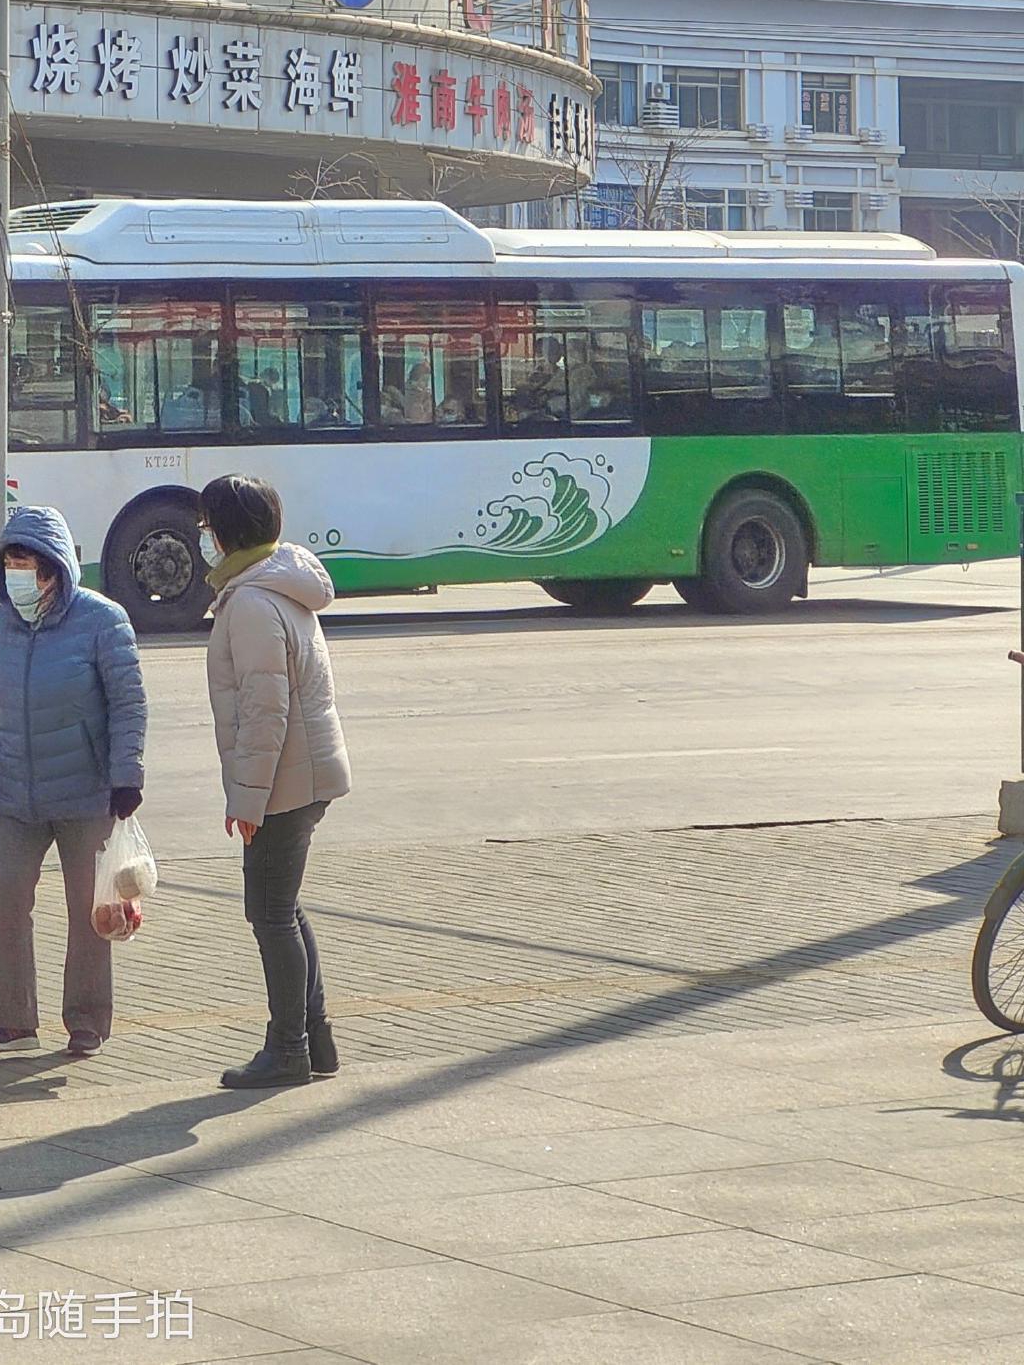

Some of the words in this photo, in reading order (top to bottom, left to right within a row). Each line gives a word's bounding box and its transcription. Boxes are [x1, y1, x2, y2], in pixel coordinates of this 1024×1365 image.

[30, 23, 142, 100] 烧烤
[169, 34, 264, 113] 炒菜
[287, 46, 364, 118] 海鲜
[391, 61, 536, 145] 淮南牛肉汤
[144, 455, 182, 468] KT227
